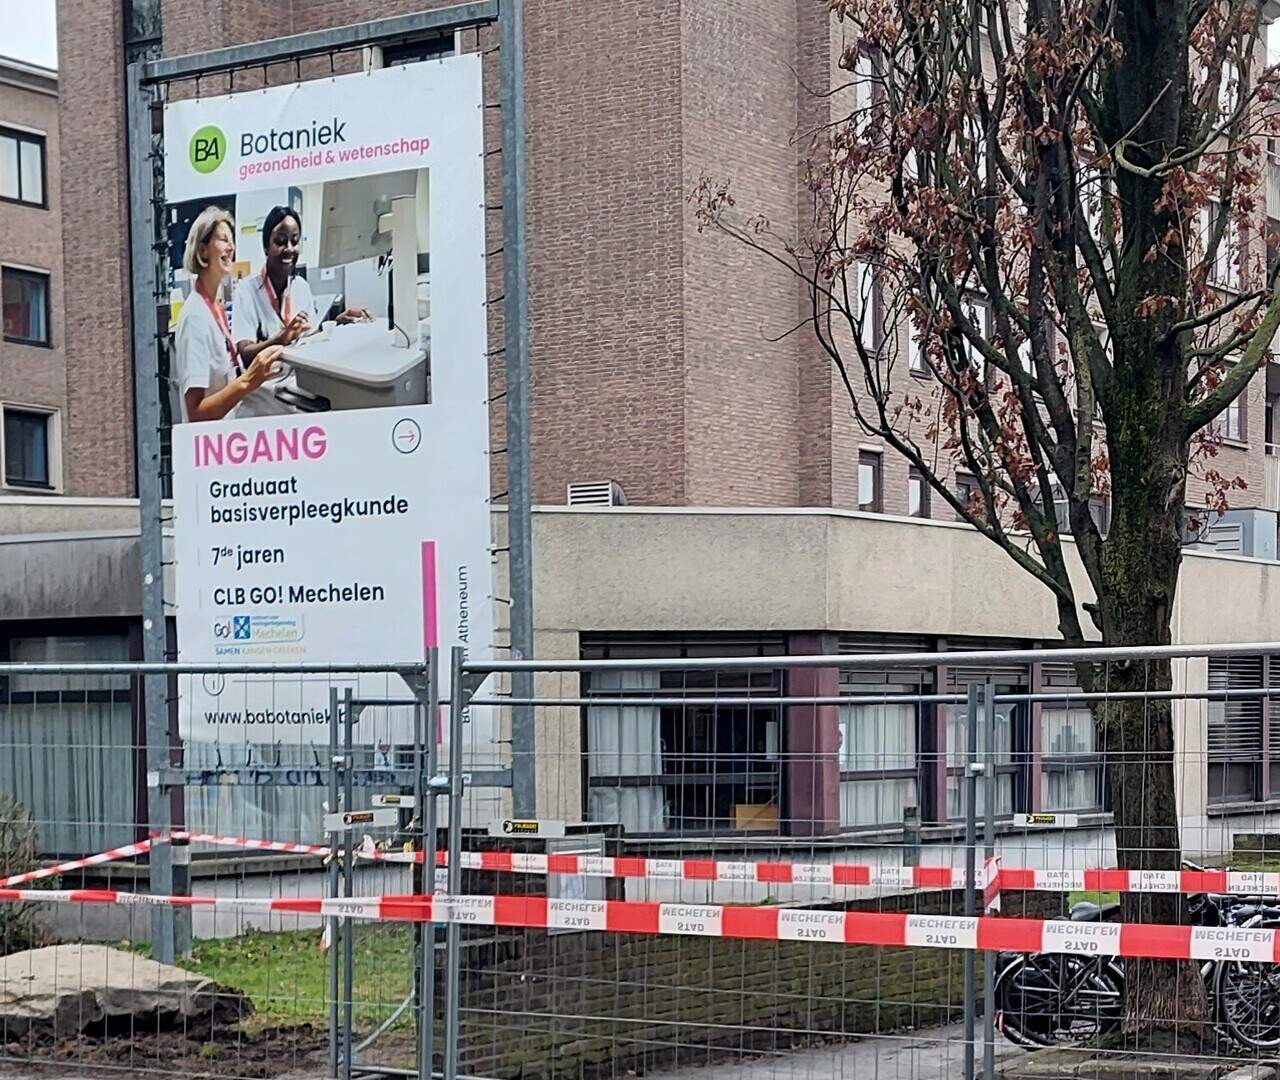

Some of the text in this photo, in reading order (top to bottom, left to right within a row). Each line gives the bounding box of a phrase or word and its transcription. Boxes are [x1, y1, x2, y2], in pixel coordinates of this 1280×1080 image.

[194, 136, 220, 163] BA
[240, 117, 346, 157] Botaniek
[239, 137, 431, 180] gezondheid & wetenschap
[194, 425, 327, 467] INGANG
[210, 477, 298, 498] Graduaat
[211, 495, 409, 525] basisverpleegkunde
[212, 544, 285, 571] 7de jaren
[214, 582, 385, 606] CLB GO! Mechelen
[457, 565, 468, 643] Atheneum
[204, 707, 361, 725] www.babotaniekb
